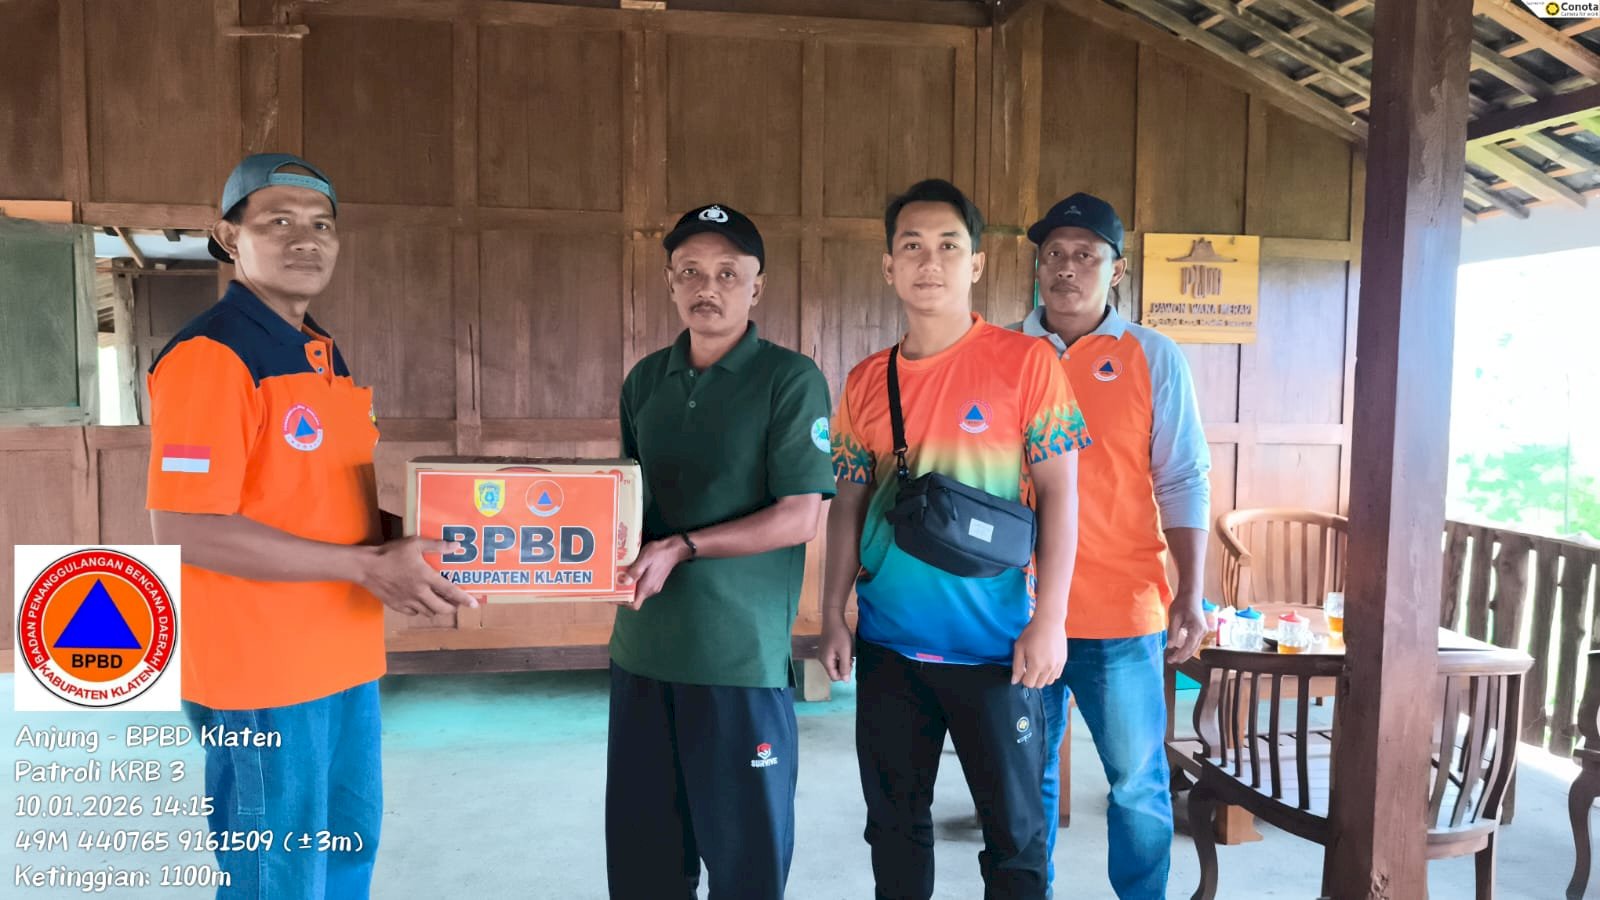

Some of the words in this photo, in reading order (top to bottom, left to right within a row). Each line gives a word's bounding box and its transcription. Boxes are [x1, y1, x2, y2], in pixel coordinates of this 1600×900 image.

[1150, 303, 1186, 314] PAWON
[1188, 303, 1216, 315] WANA
[441, 525, 596, 564] BPBD
[535, 571, 593, 585] KLATEN
